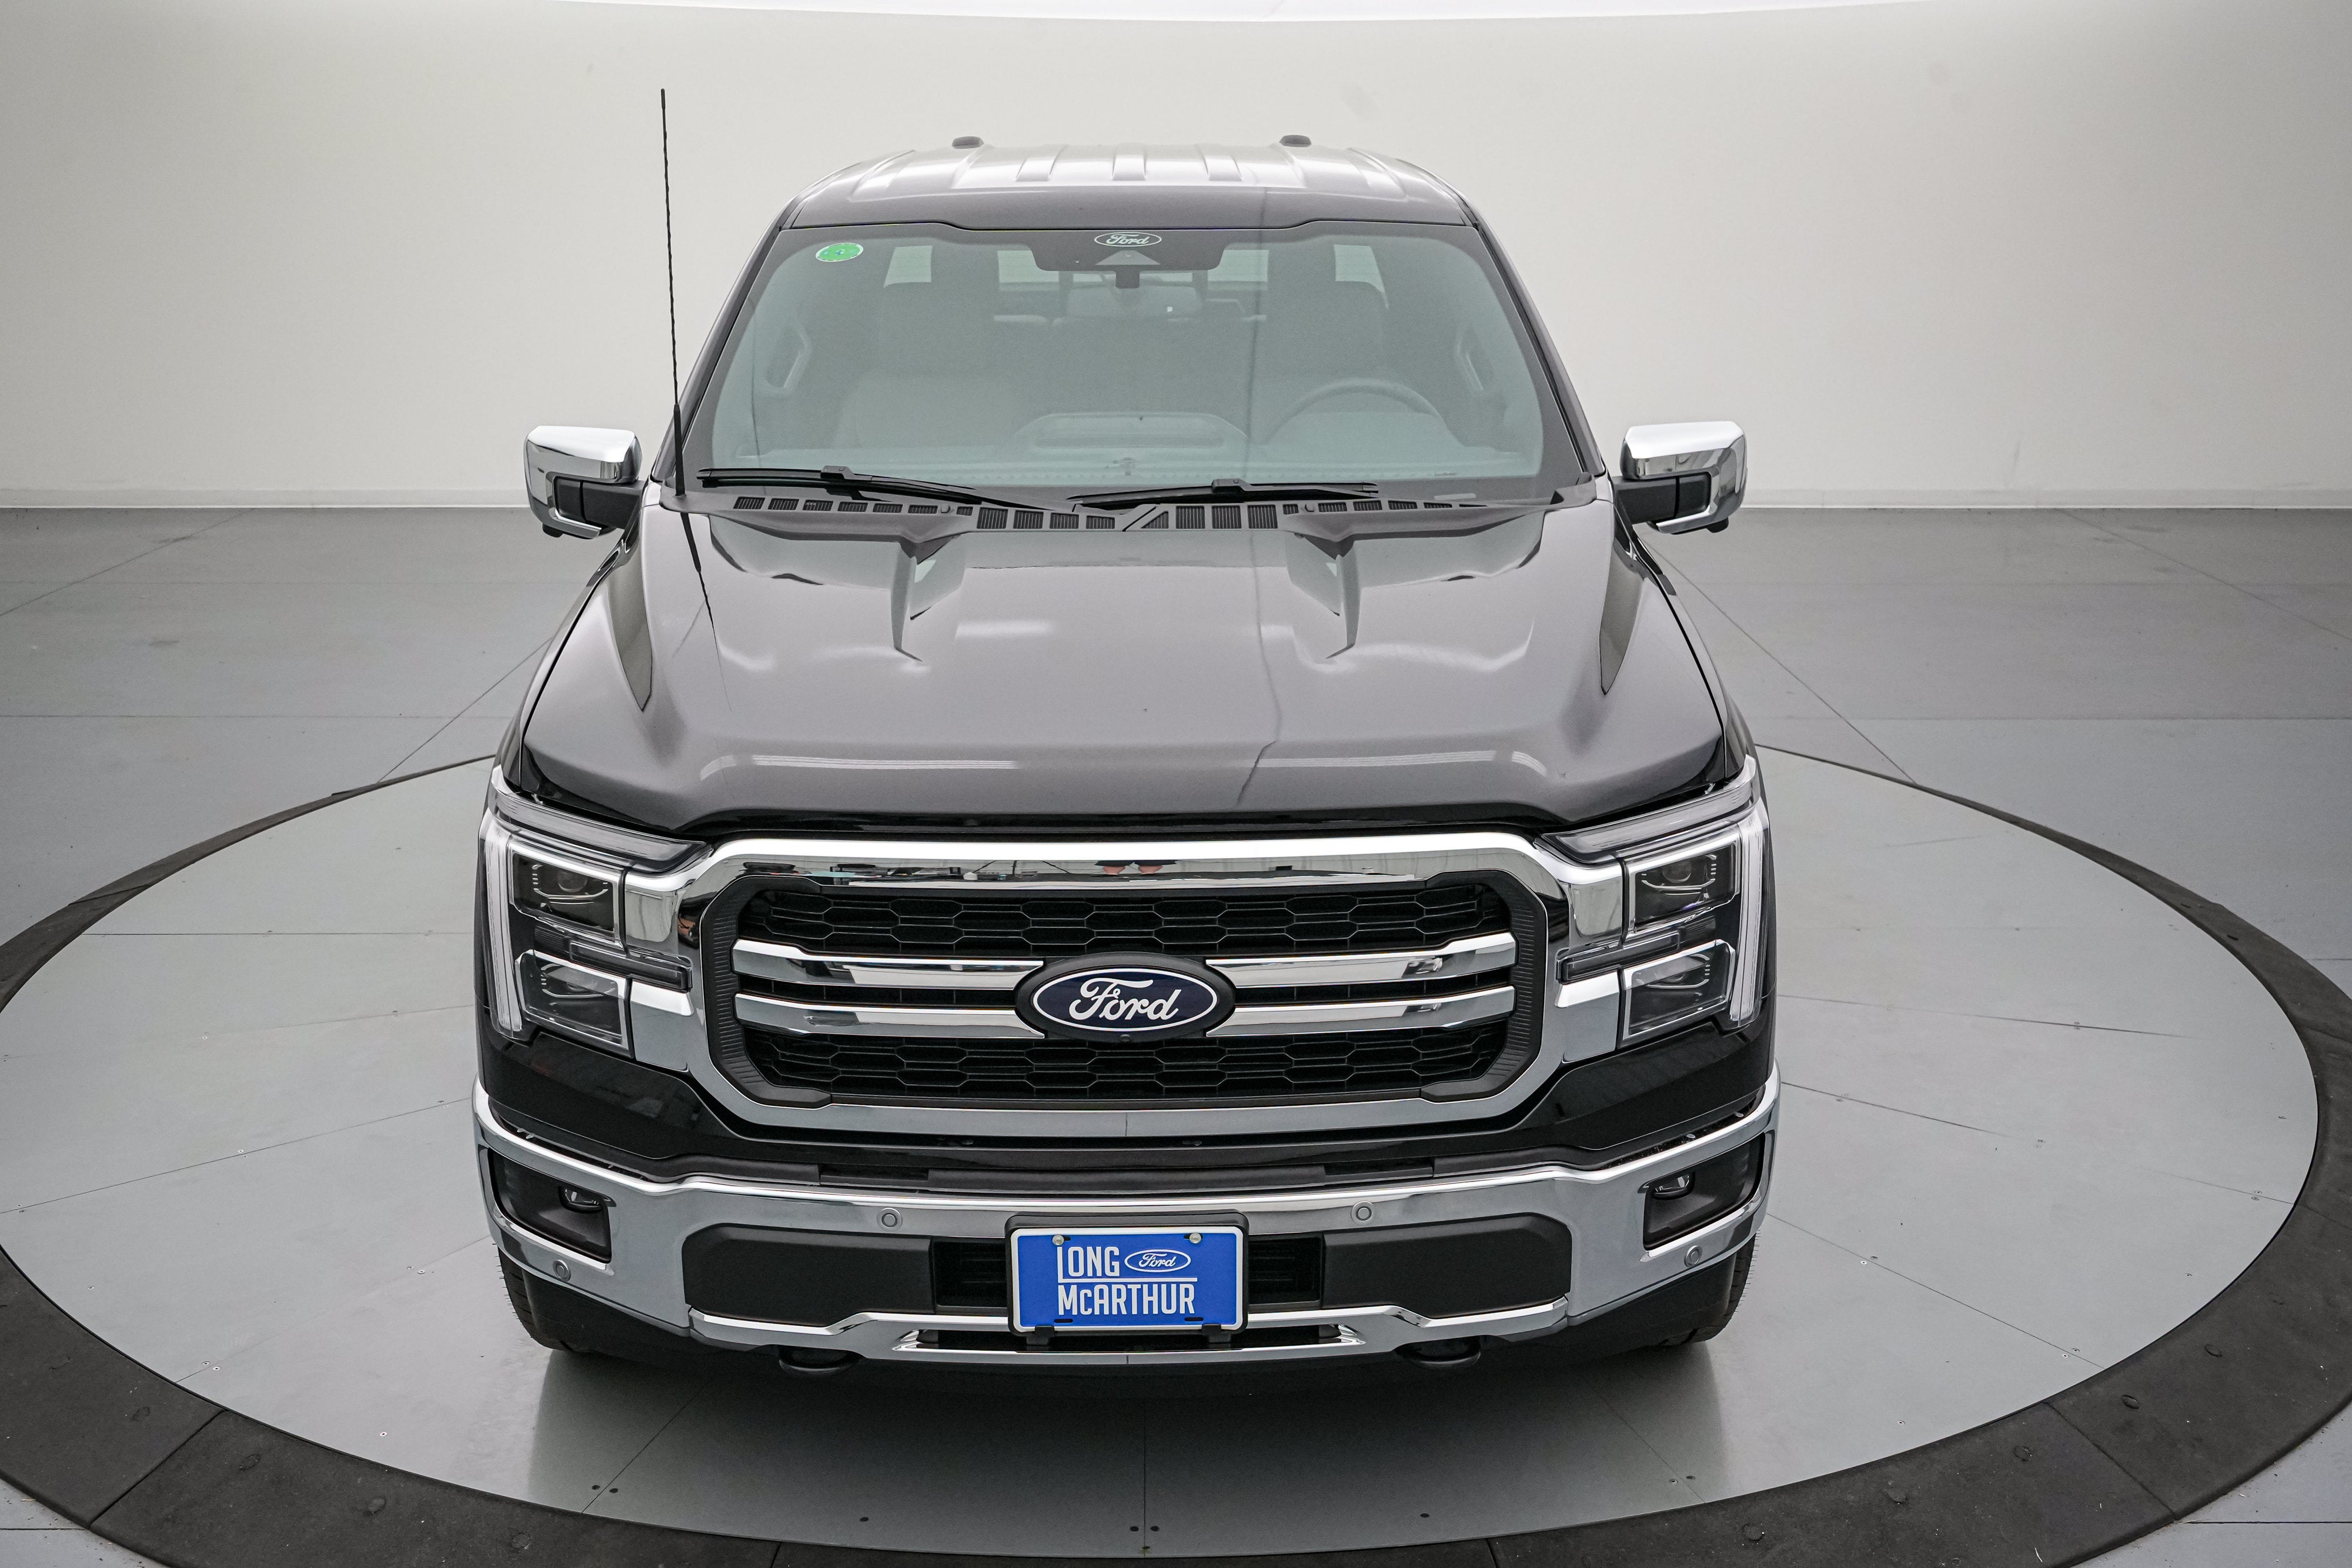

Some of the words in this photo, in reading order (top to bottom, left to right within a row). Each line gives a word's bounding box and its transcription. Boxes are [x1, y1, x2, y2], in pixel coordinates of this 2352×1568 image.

[1106, 233, 1150, 245] Ford
[1068, 977, 1182, 1021] Ford
[1057, 1246, 1120, 1283] LONG
[1138, 1253, 1177, 1268] Ford
